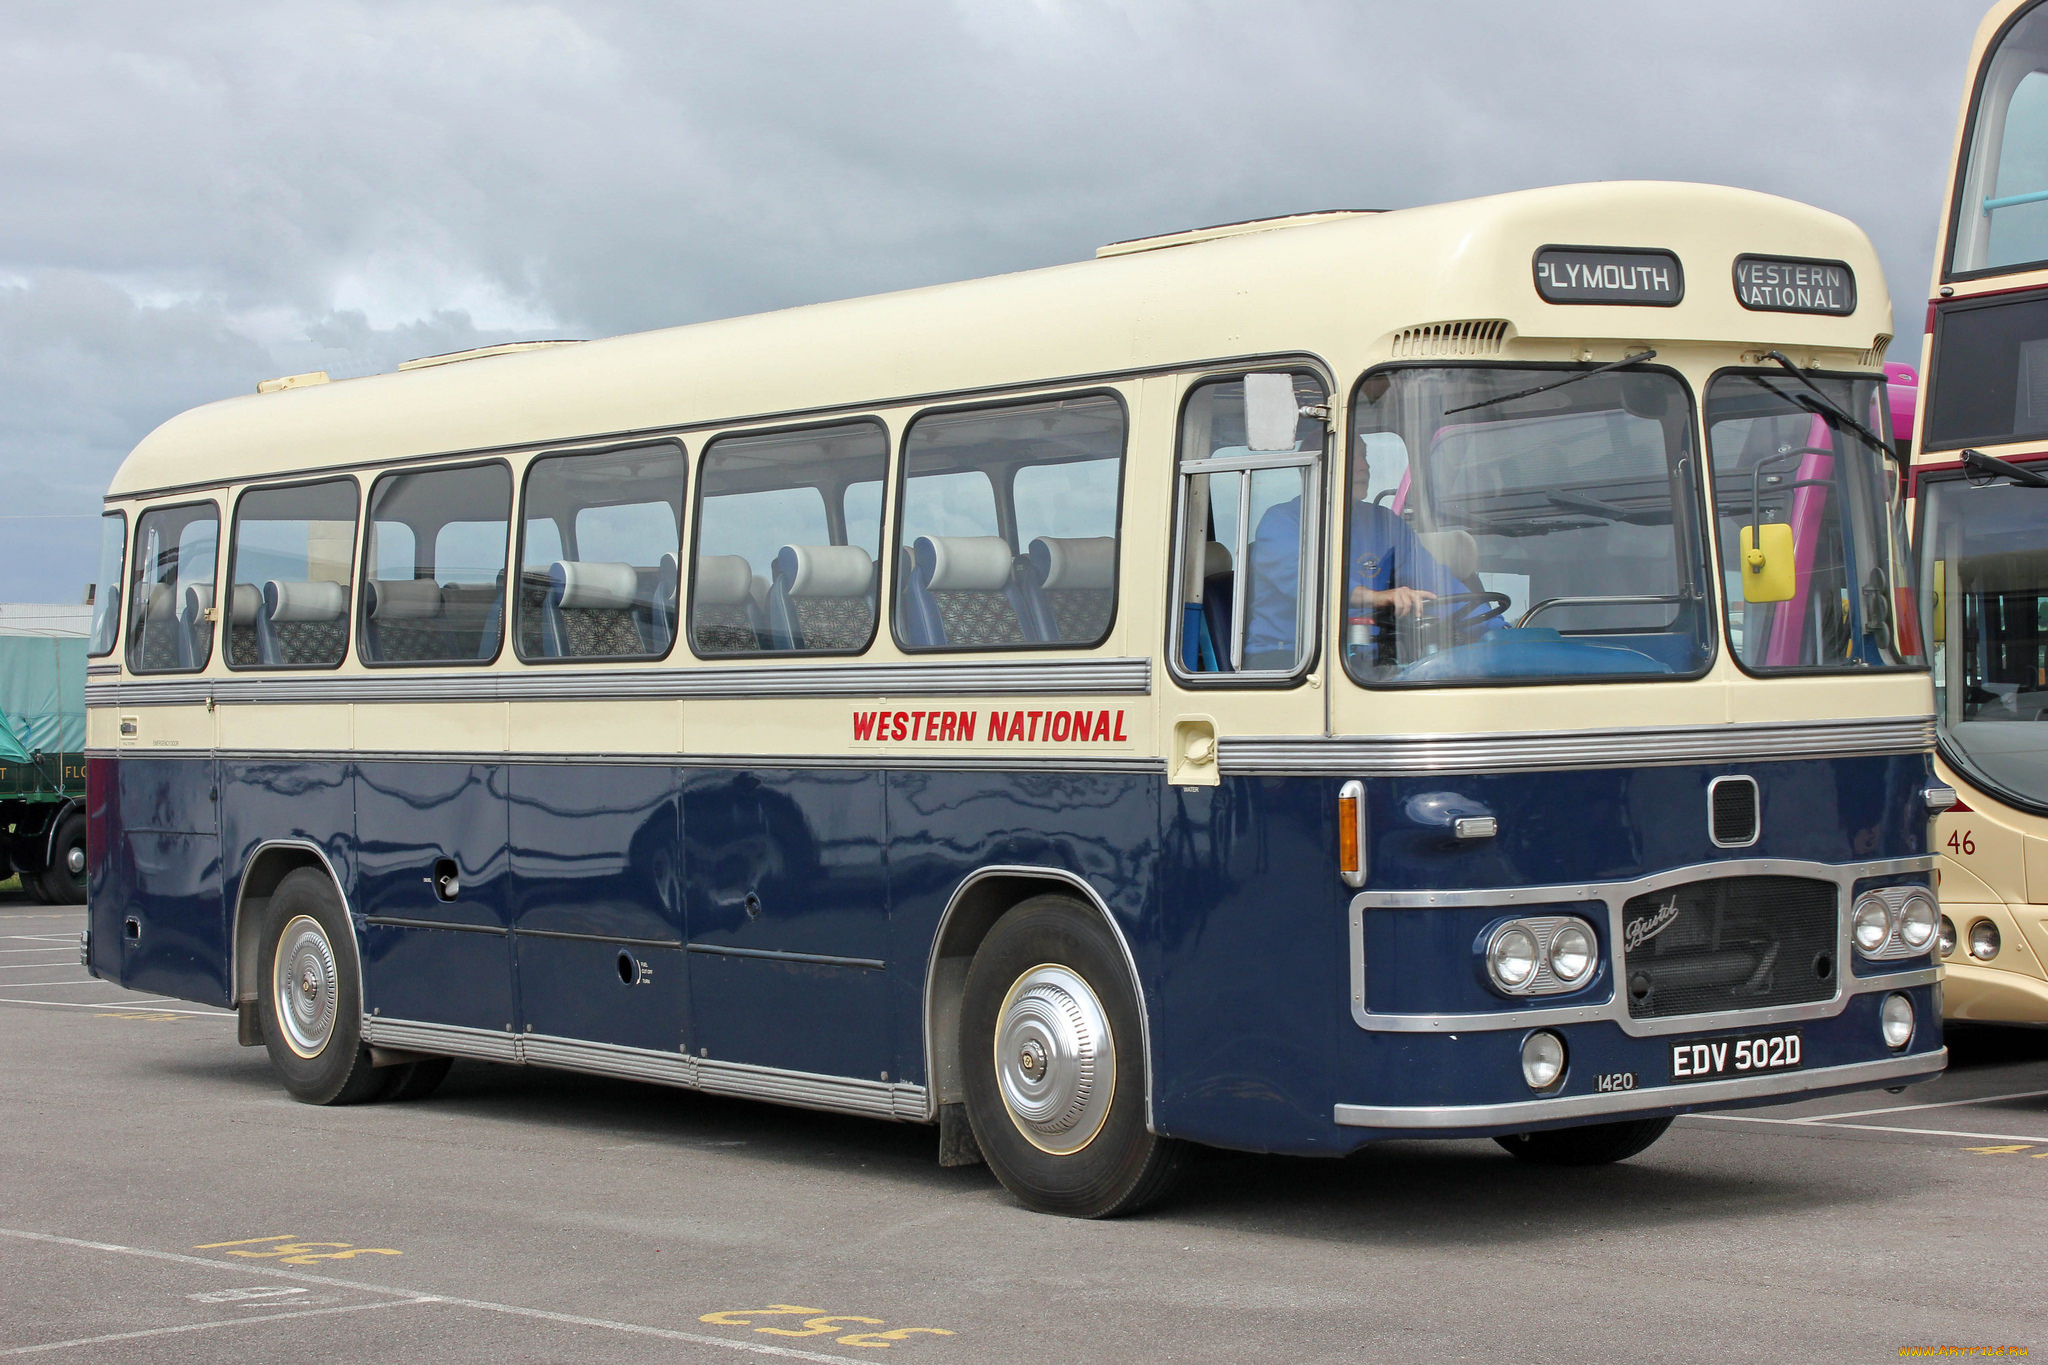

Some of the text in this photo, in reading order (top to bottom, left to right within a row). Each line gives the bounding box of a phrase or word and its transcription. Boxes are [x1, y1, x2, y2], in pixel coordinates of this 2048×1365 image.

[853, 710, 1128, 741] WESTERN NATIONAL
[1947, 829, 1976, 855] 46
[1673, 1035, 1801, 1077] EDV 502D
[1598, 1073, 1634, 1092] 1420
